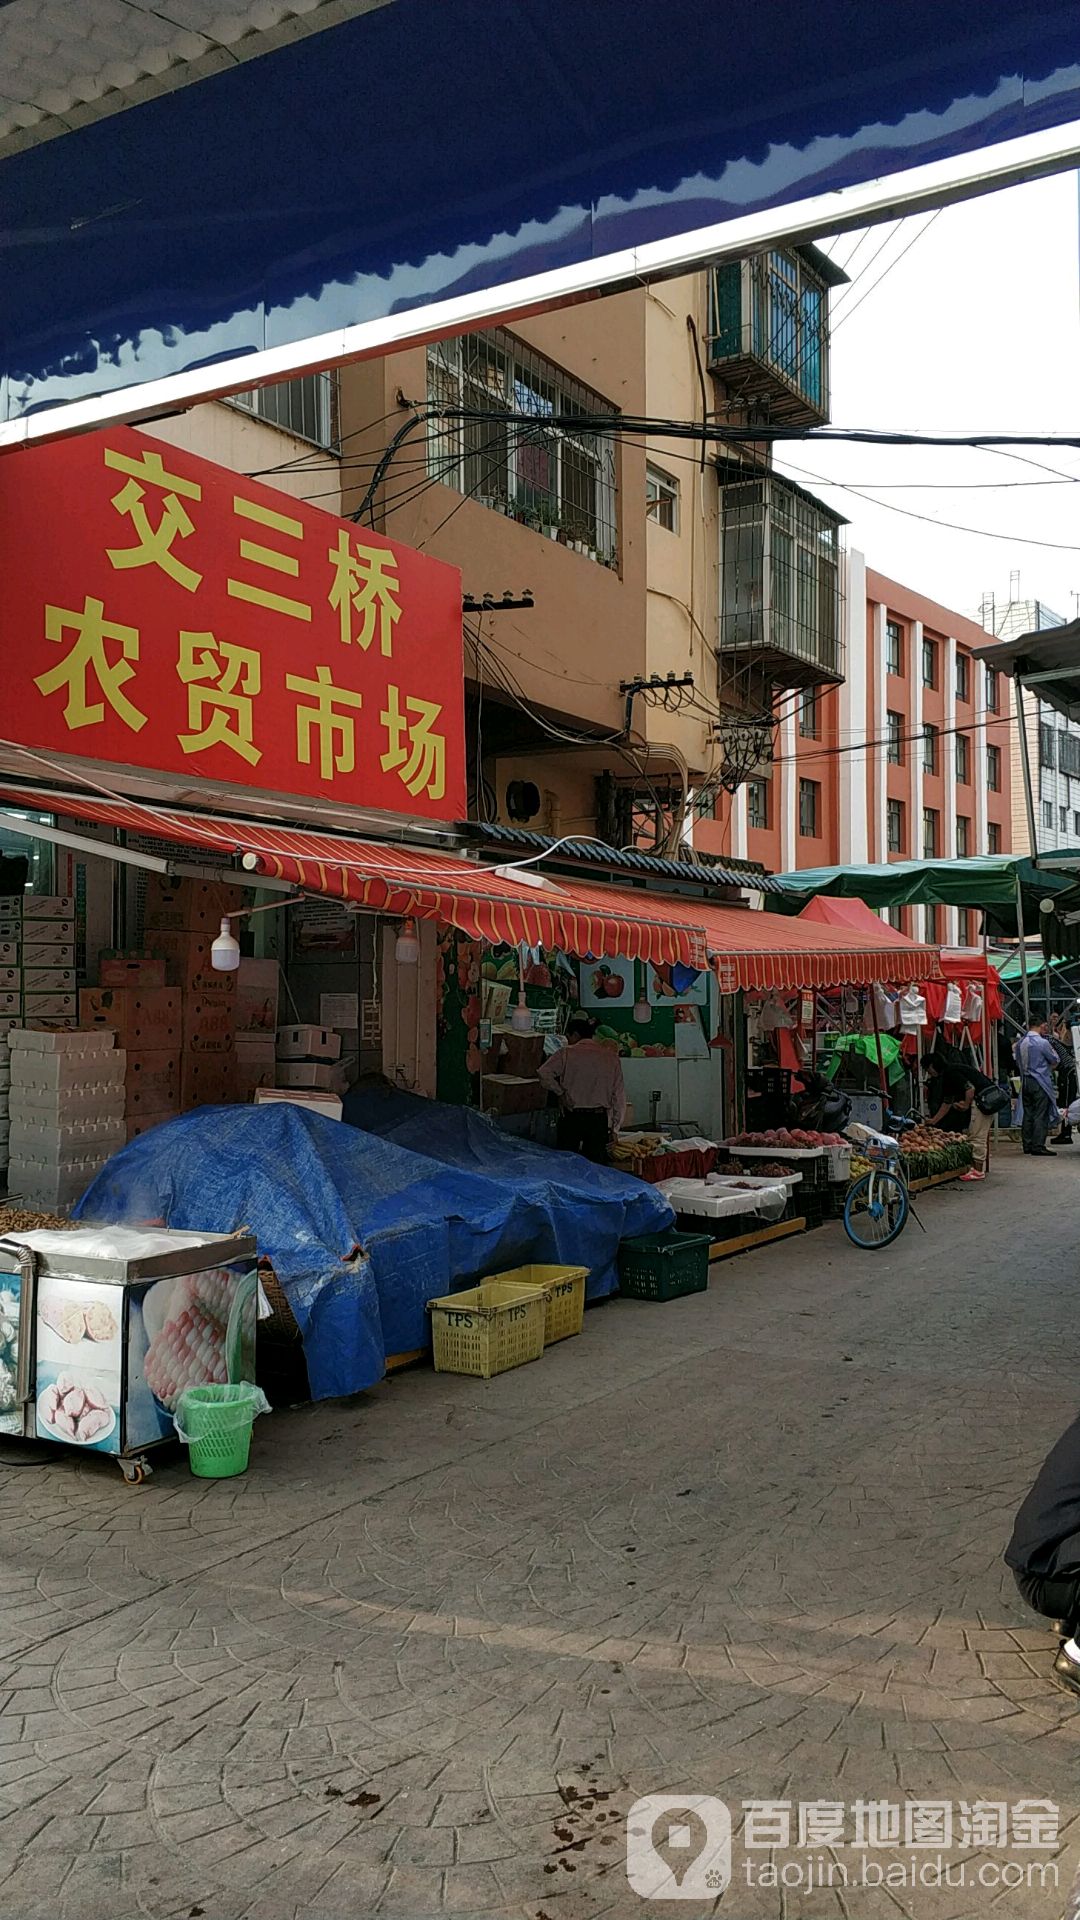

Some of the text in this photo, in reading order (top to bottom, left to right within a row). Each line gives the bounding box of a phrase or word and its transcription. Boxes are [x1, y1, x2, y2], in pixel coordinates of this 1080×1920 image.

[104, 448, 402, 657] 交三桥
[33, 596, 446, 799] 农贸市场
[555, 1283, 573, 1297] TPS
[445, 1311, 473, 1328] TPS
[508, 1305, 527, 1322] TPS
